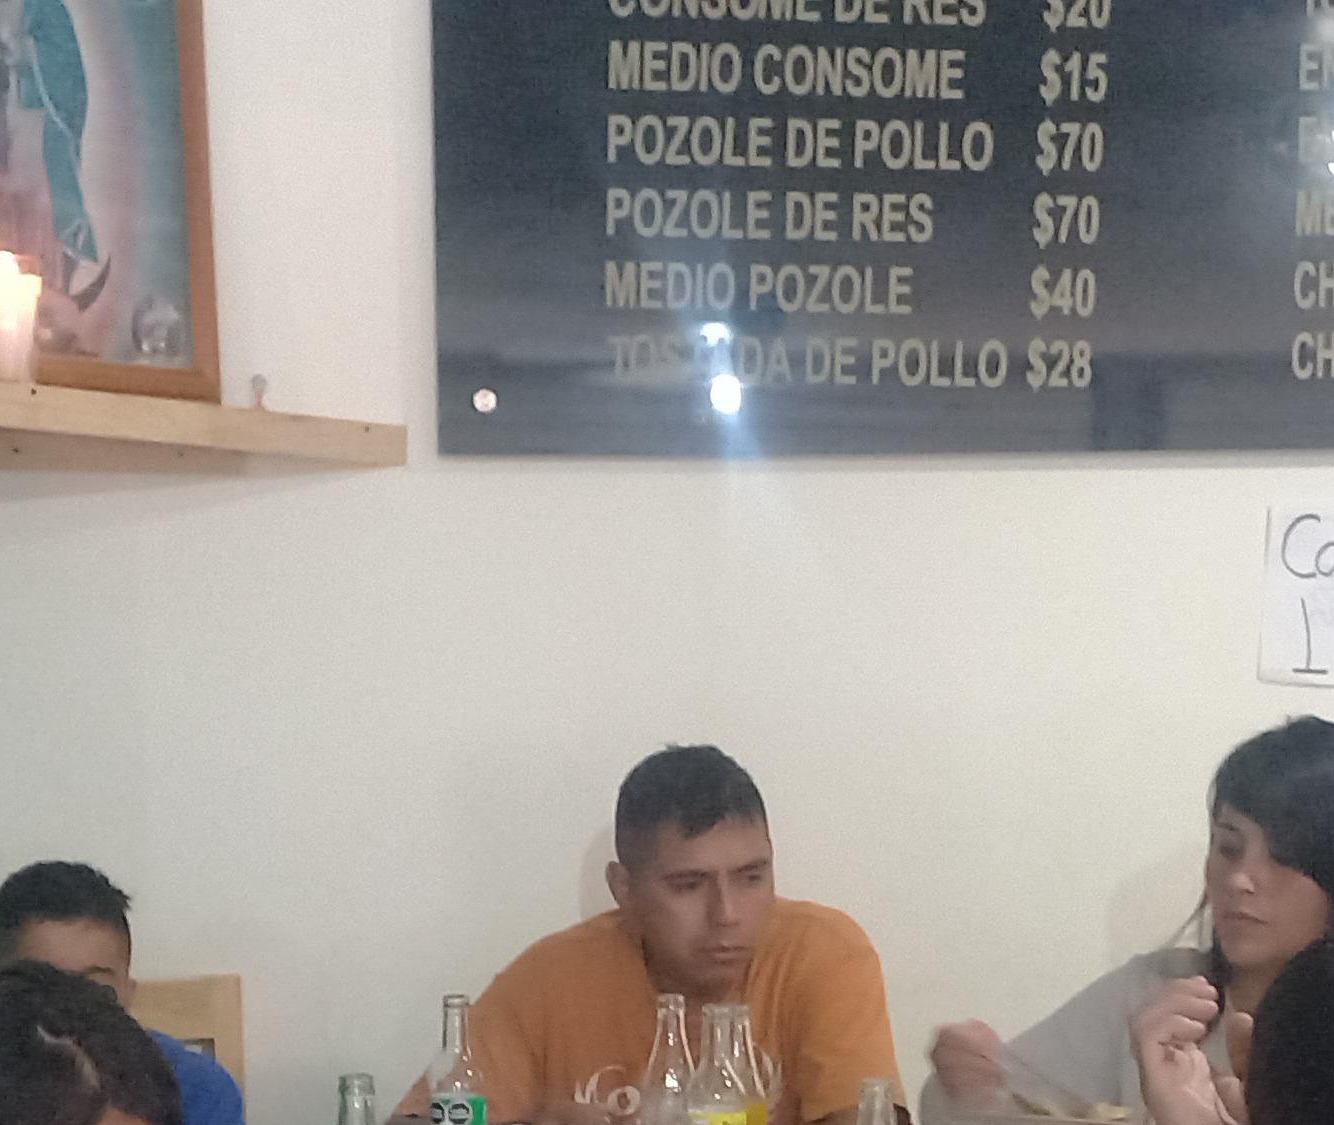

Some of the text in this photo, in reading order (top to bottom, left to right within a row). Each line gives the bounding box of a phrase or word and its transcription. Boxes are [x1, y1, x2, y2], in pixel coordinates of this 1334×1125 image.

[608, 40, 966, 99] MEDIO CONSOME
[1039, 48, 1108, 107] $15
[607, 114, 994, 171] POZOLE DE POLLO
[1036, 117, 1104, 176] $70
[605, 188, 934, 243] POZOLE DE RES
[1033, 191, 1100, 249] $70
[605, 260, 914, 314] MEDIO POZOLE
[1030, 264, 1096, 320] $40
[805, 336, 859, 385] DE
[871, 338, 1009, 388] POLLO
[1026, 336, 1093, 392] $28
